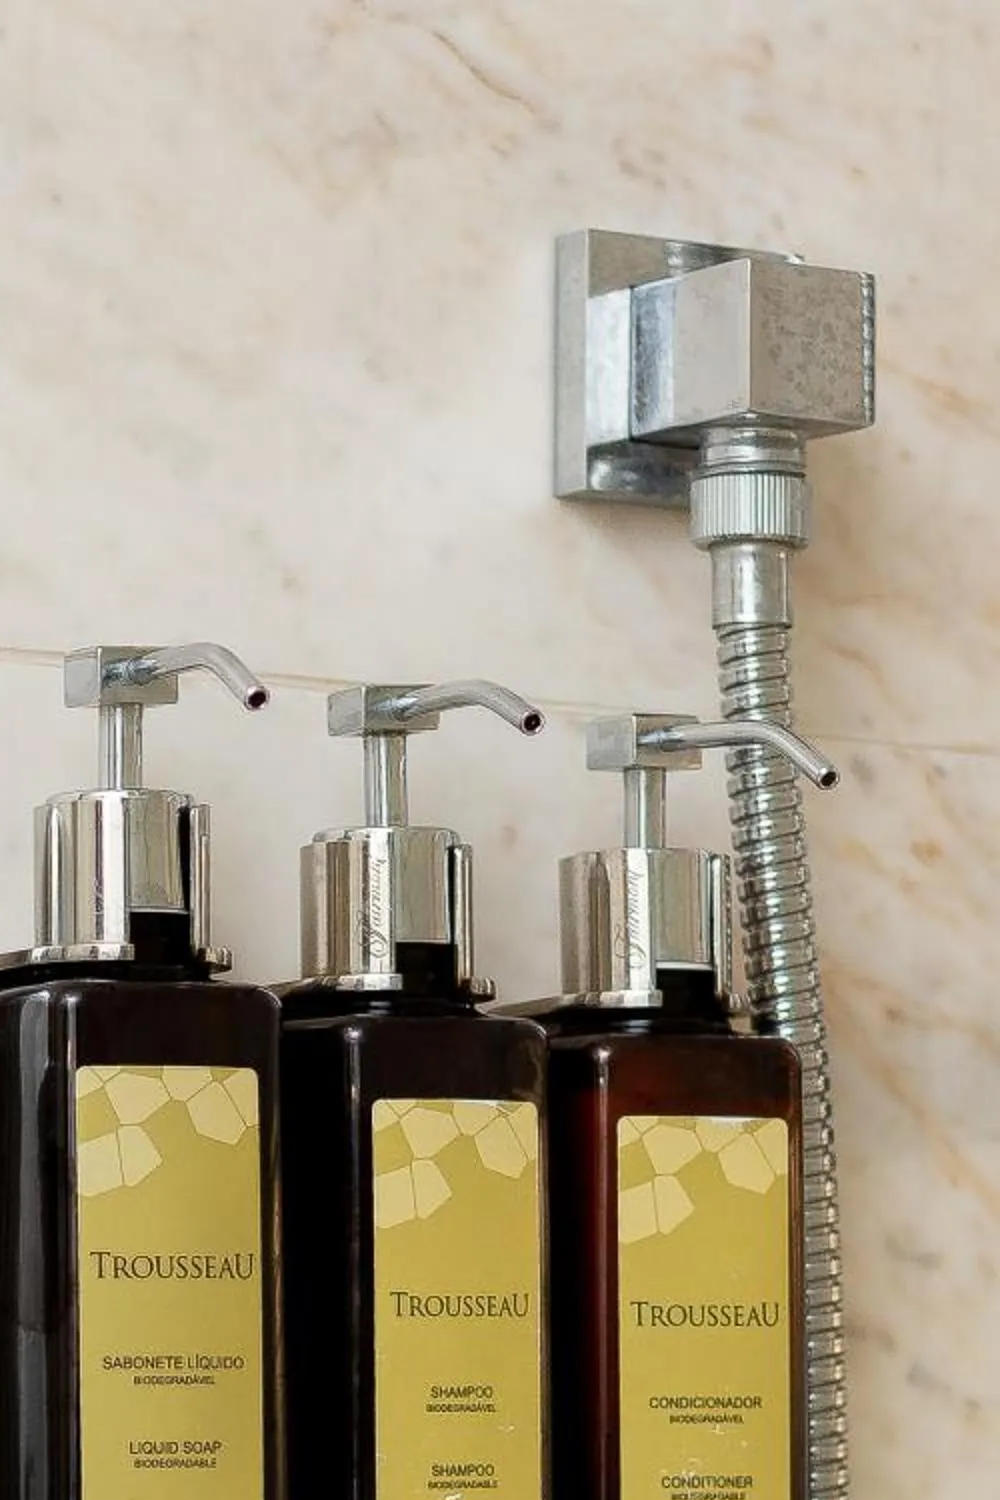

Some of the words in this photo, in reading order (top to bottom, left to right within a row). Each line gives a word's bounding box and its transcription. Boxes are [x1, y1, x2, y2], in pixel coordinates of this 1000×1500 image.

[89, 1251, 254, 1279] TROUSSEAU
[389, 1291, 529, 1317] TROUSSEAU
[630, 1301, 779, 1327] TROUSSEAU
[103, 1355, 183, 1370] SABONETE
[187, 1354, 245, 1370] LÍQUIDO
[430, 1386, 493, 1399] SHAMPOO
[649, 1397, 762, 1409] CONDICIONADOR
[129, 1441, 179, 1455] LIQUID
[183, 1441, 222, 1454] SOAP
[133, 1458, 217, 1469] BIODEGRADABLE
[431, 1464, 495, 1477] SHAMPOO
[661, 1475, 753, 1488] CONDITIONER
